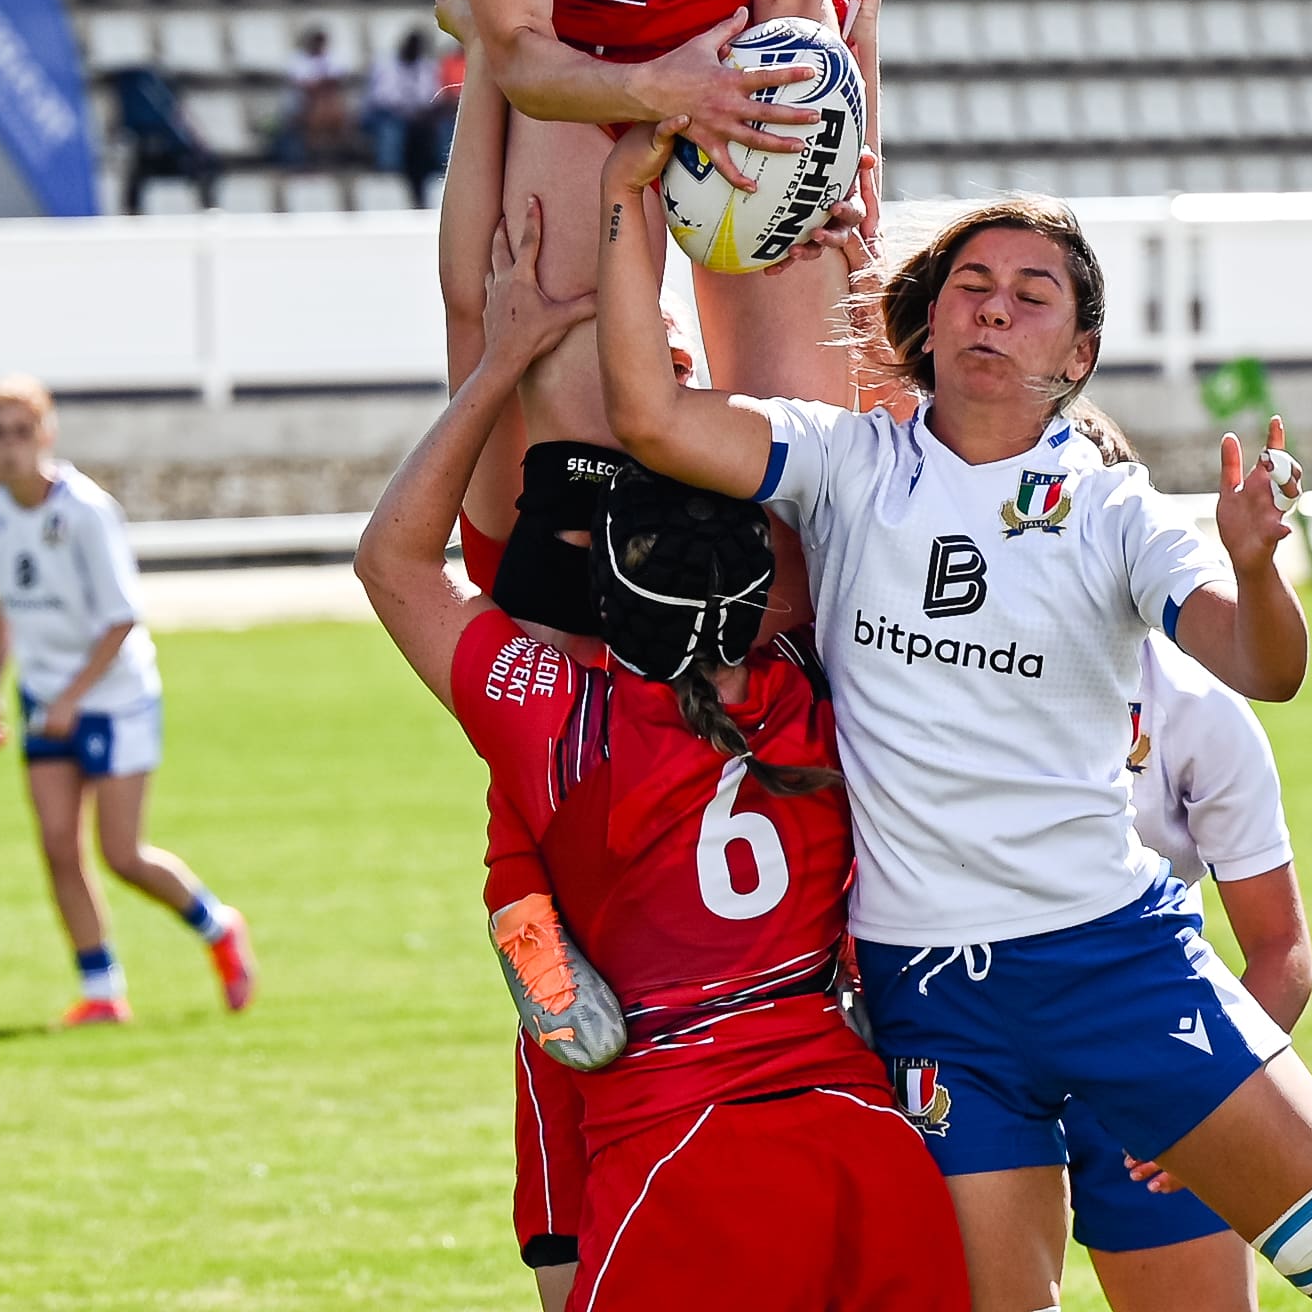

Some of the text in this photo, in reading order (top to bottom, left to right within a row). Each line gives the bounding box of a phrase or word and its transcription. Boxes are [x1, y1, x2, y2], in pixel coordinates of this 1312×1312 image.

[751, 108, 846, 260] RHINO
[778, 135, 816, 201] VORTEX
[755, 205, 787, 242] ELITE
[567, 457, 618, 476] SELEC
[1020, 521, 1049, 529] ITALIA
[854, 609, 1044, 679] bitpanda
[696, 755, 789, 920] 6
